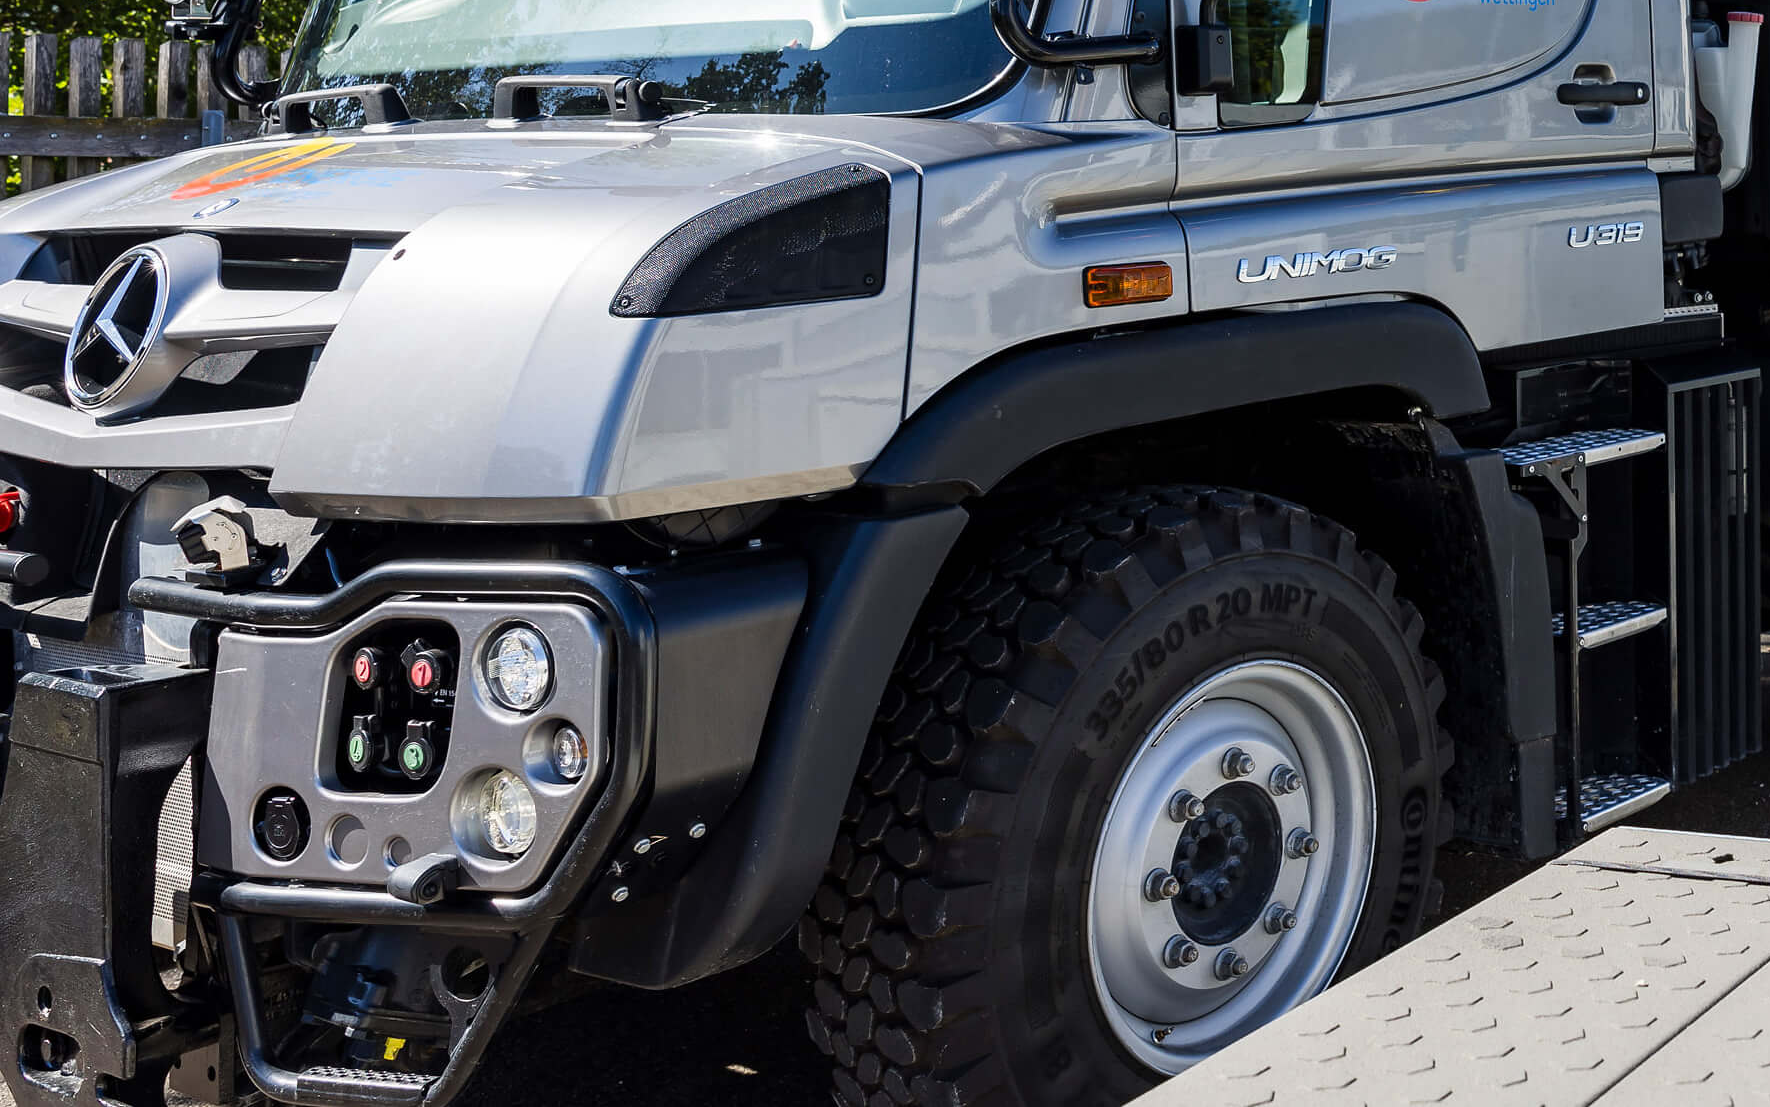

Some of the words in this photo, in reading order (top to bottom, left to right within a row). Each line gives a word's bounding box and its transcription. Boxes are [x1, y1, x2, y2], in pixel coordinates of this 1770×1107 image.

[1568, 220, 1644, 249] U319
[1236, 244, 1398, 284] UNIMOG
[1084, 620, 1185, 740] 335/80
[1187, 603, 1214, 638] R
[1216, 586, 1253, 624] 20
[1259, 581, 1319, 618] MPT
